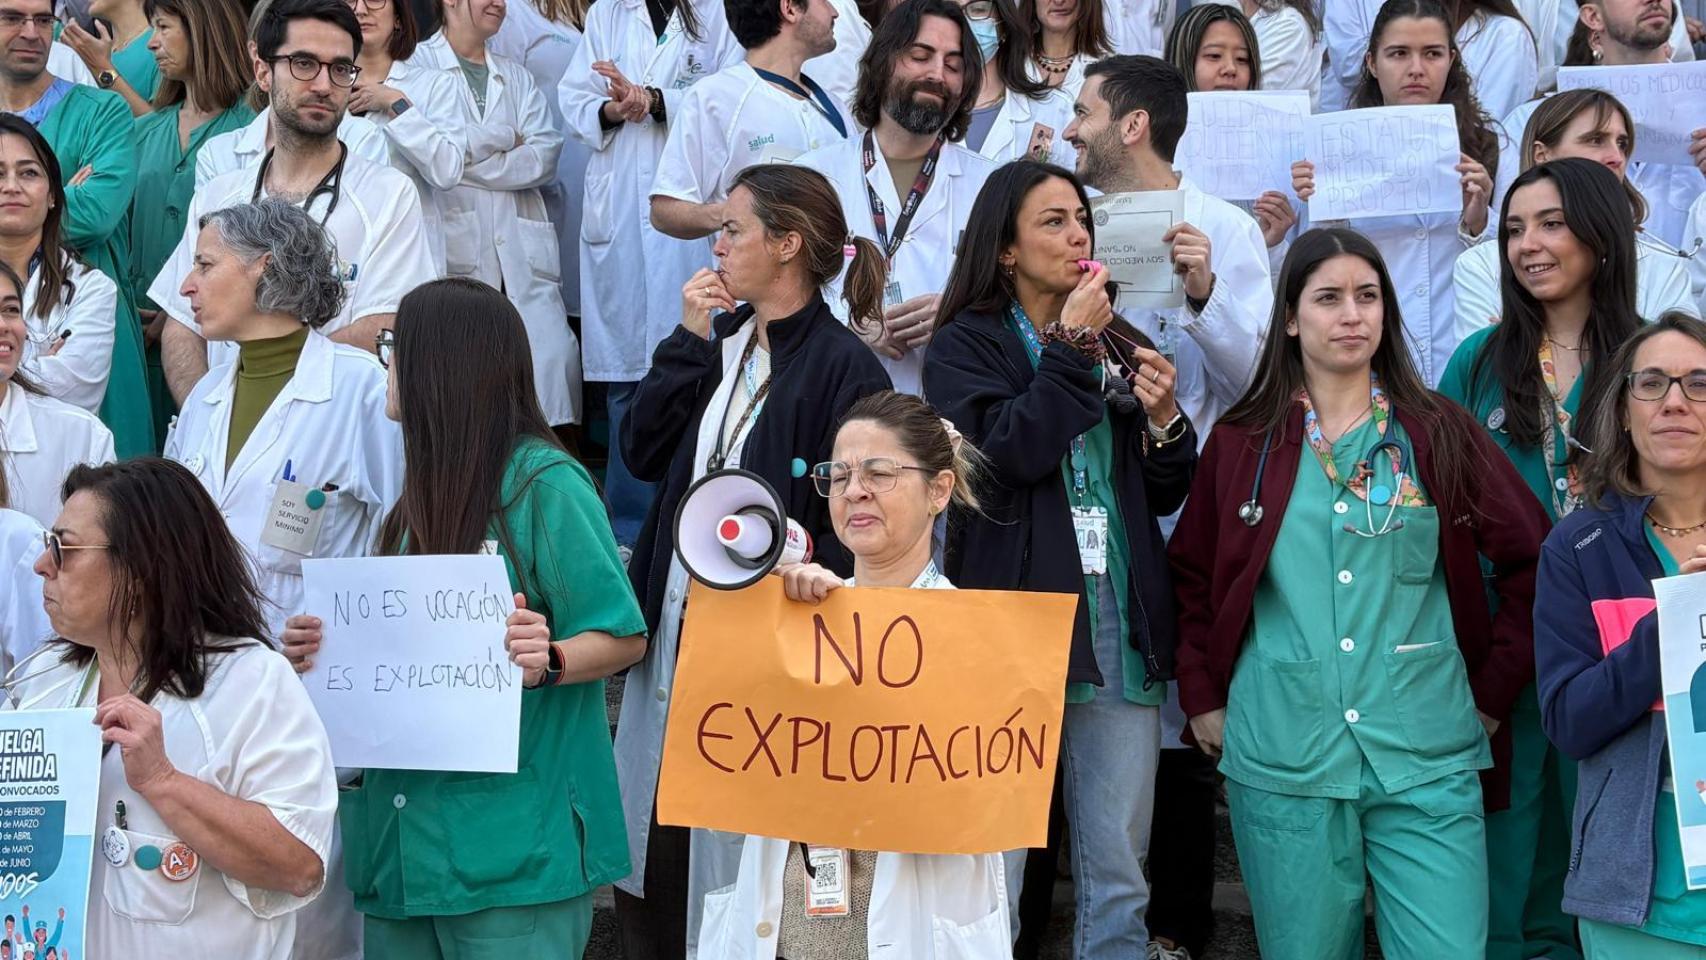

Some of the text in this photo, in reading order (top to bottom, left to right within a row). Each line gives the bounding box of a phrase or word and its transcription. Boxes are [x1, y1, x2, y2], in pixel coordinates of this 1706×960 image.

[748, 133, 775, 148] salud
[1321, 113, 1456, 158] ESTATUTO
[1146, 255, 1166, 264] SOY
[281, 500, 296, 509] SOY
[278, 510, 309, 525] SERVICIO
[334, 582, 508, 628] NO ES VOCACIÓN
[813, 612, 923, 688] NO
[326, 646, 512, 693] ES EXPLOTACIÓN
[697, 702, 1047, 784] EXPLOTACIÓN
[0, 785, 60, 796] ONVOCADOS
[14, 806, 46, 816] FEBRERO
[13, 819, 39, 828] MARZO
[13, 832, 32, 841] ABRIL
[12, 845, 34, 854] MAYO
[9, 858, 31, 868] JUNIO
